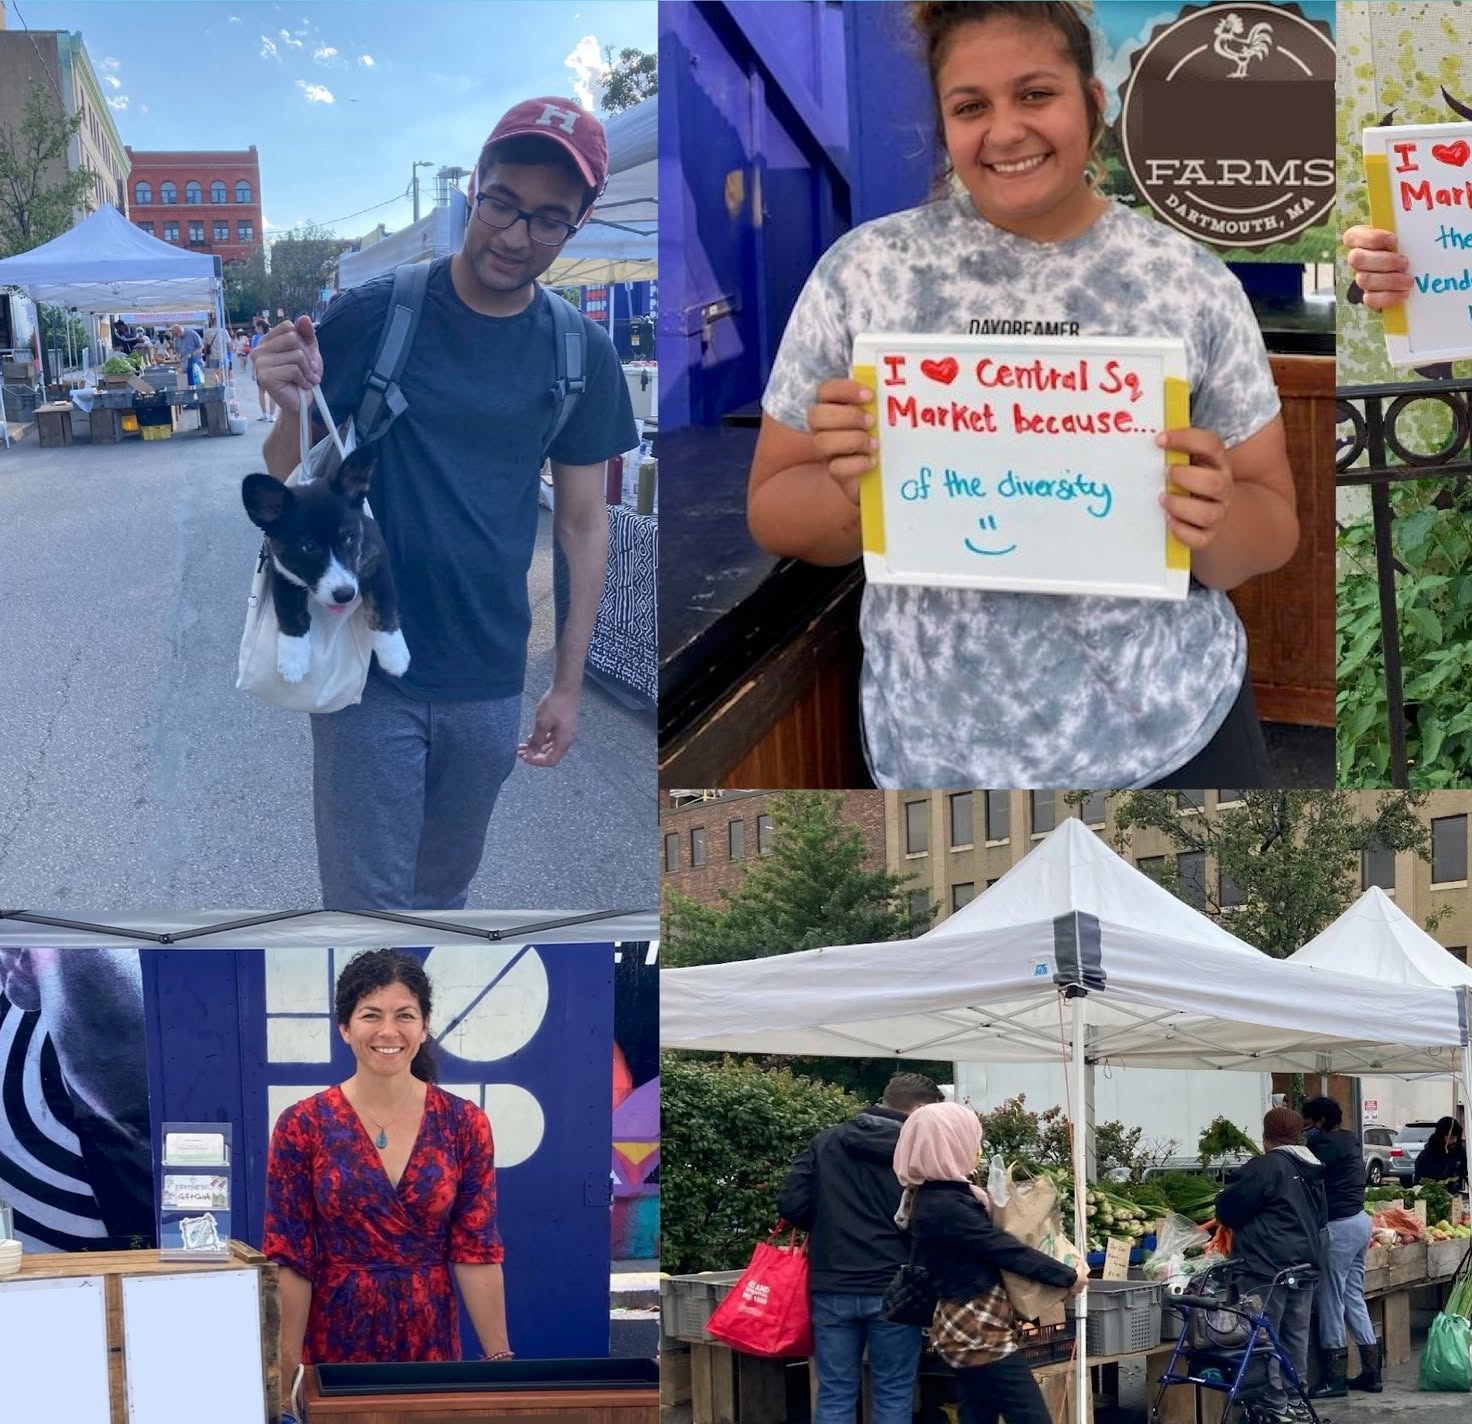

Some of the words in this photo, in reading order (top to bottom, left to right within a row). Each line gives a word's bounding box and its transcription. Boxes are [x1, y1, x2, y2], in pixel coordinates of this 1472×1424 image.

[536, 104, 580, 134] H
[1145, 158, 1335, 186] FARMS
[1393, 142, 1419, 173] I
[1165, 194, 1285, 234] DARTMOUTH,
[1286, 197, 1315, 221] MA
[884, 356, 906, 386] I
[975, 358, 1089, 392] Central
[1098, 360, 1144, 402] Sq
[887, 396, 998, 434] Market
[1012, 402, 1158, 434] because...
[901, 467, 932, 500] of
[944, 469, 987, 498] the
[998, 469, 1112, 518] diversity
